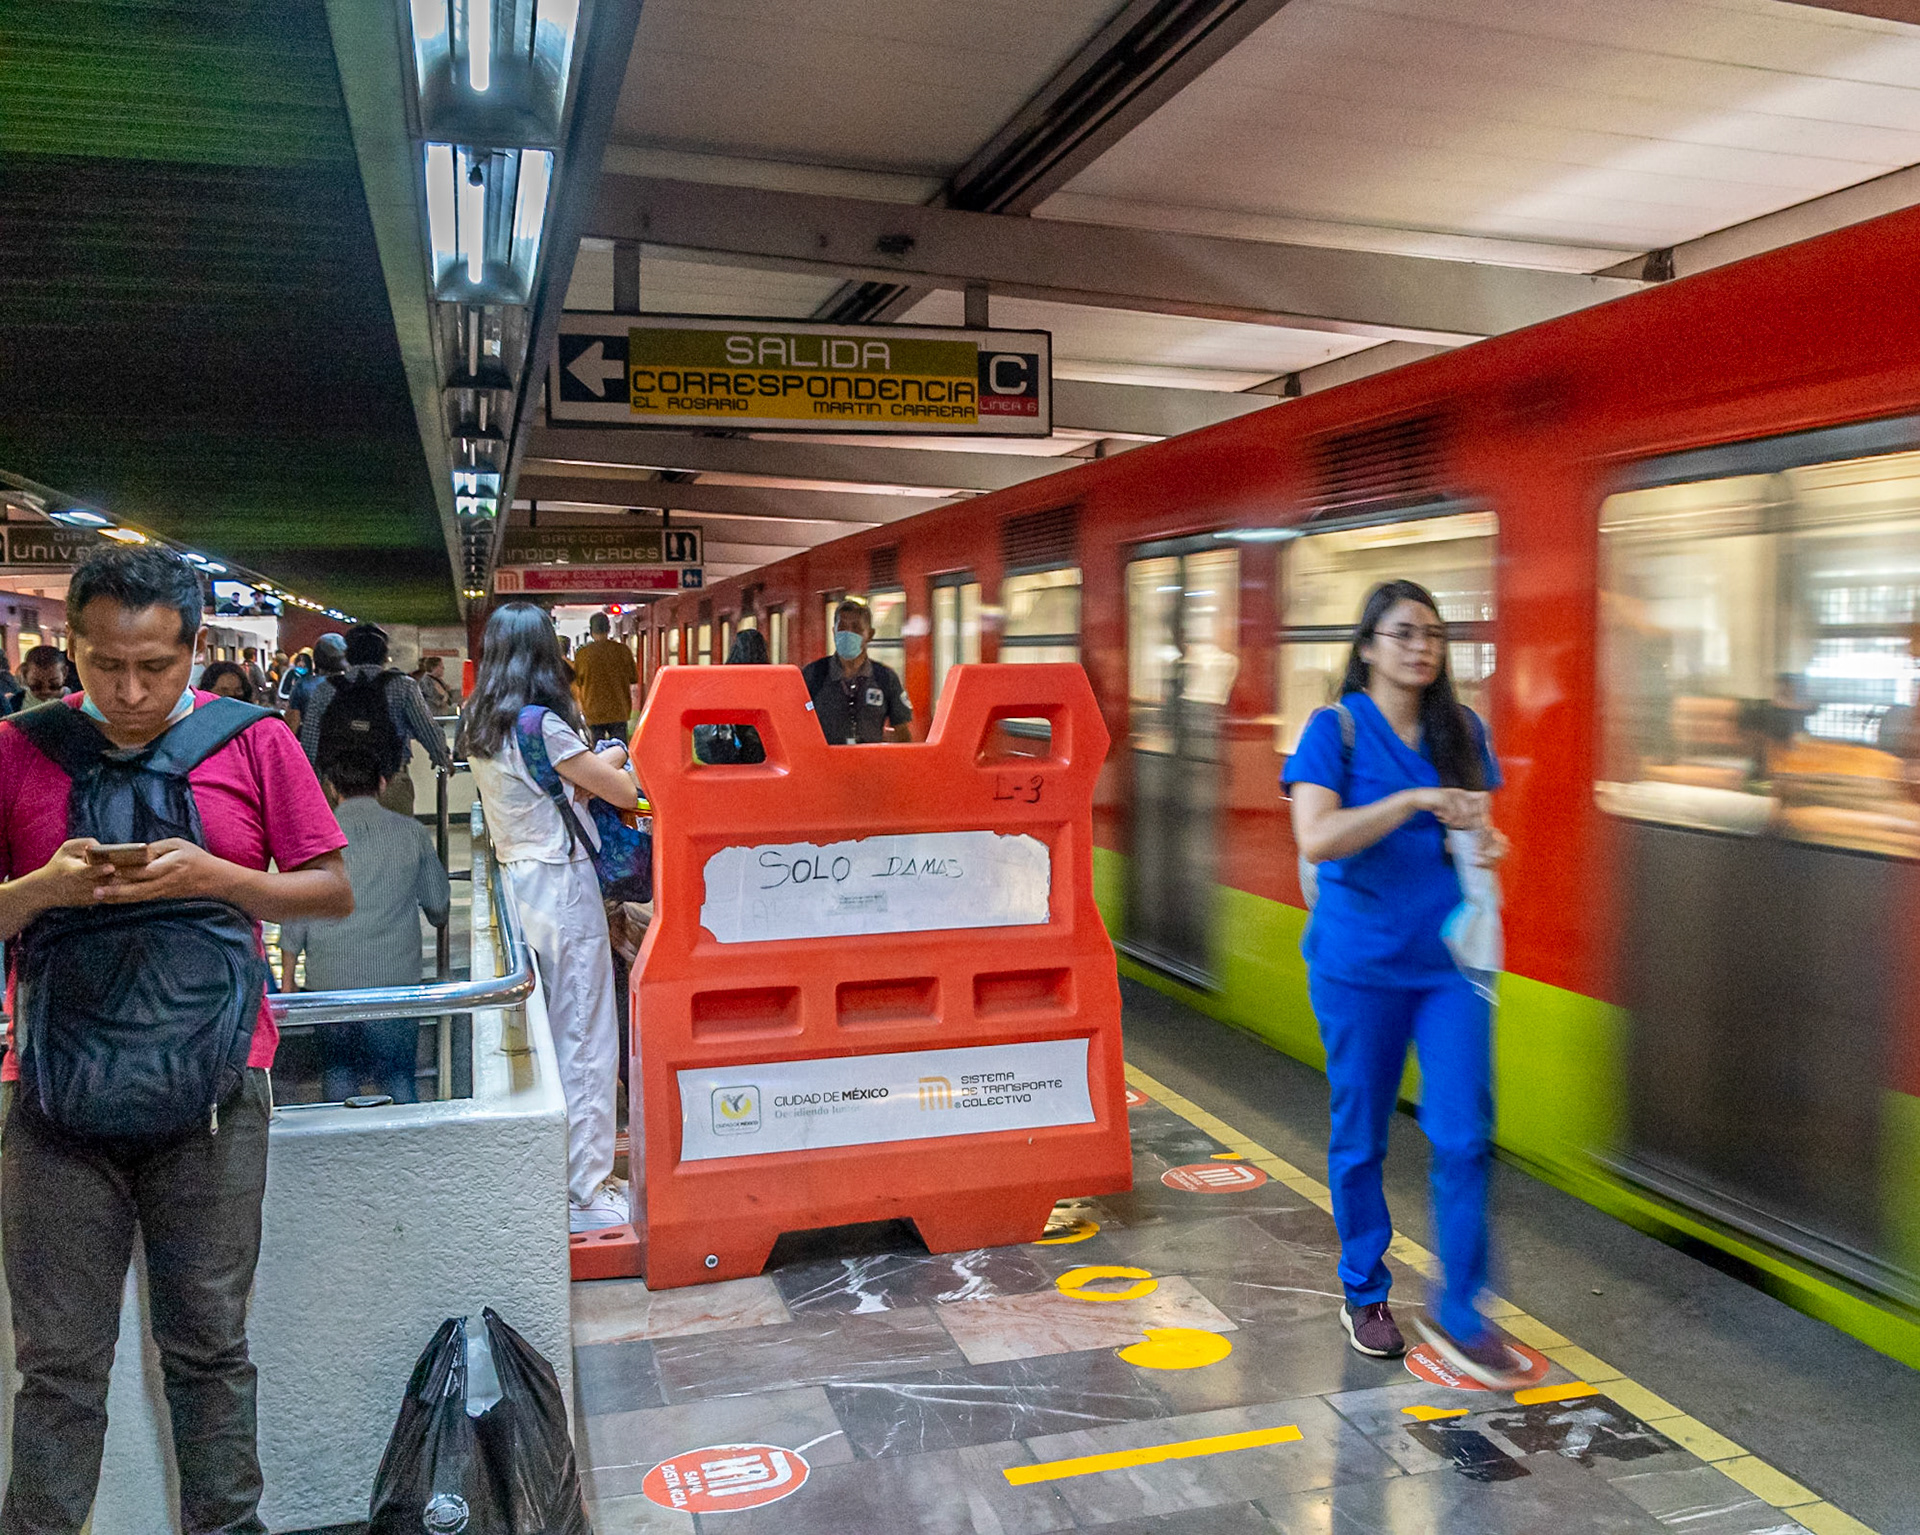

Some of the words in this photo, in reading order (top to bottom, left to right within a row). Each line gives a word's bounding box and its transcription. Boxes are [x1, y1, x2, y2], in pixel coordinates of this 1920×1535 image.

[725, 336, 891, 370] SALIDA
[989, 354, 1028, 396] C
[632, 370, 976, 403] CORRESPONDENCIA
[633, 396, 659, 409] EL
[667, 396, 749, 411] ROSARIO
[813, 401, 882, 415] MARTIN
[890, 403, 976, 418] CARRERA
[979, 400, 1021, 412] LINEA
[1026, 402, 1038, 412] 6
[507, 548, 570, 561] INDIOS
[581, 548, 660, 561] VERDES
[992, 775, 1044, 803] L-3
[759, 851, 851, 889] SOLO
[871, 856, 964, 879] DAMAS
[960, 1072, 1015, 1085] SISTEMA
[961, 1086, 978, 1096] DE
[981, 1079, 1063, 1094] TRANSPORTE
[774, 1093, 822, 1107] CIUDAD
[823, 1091, 840, 1102] DE
[841, 1087, 889, 1101] MÉXICO
[962, 1093, 1032, 1108] COLECTIVO
[1412, 1353, 1461, 1387] DISTANCIA
